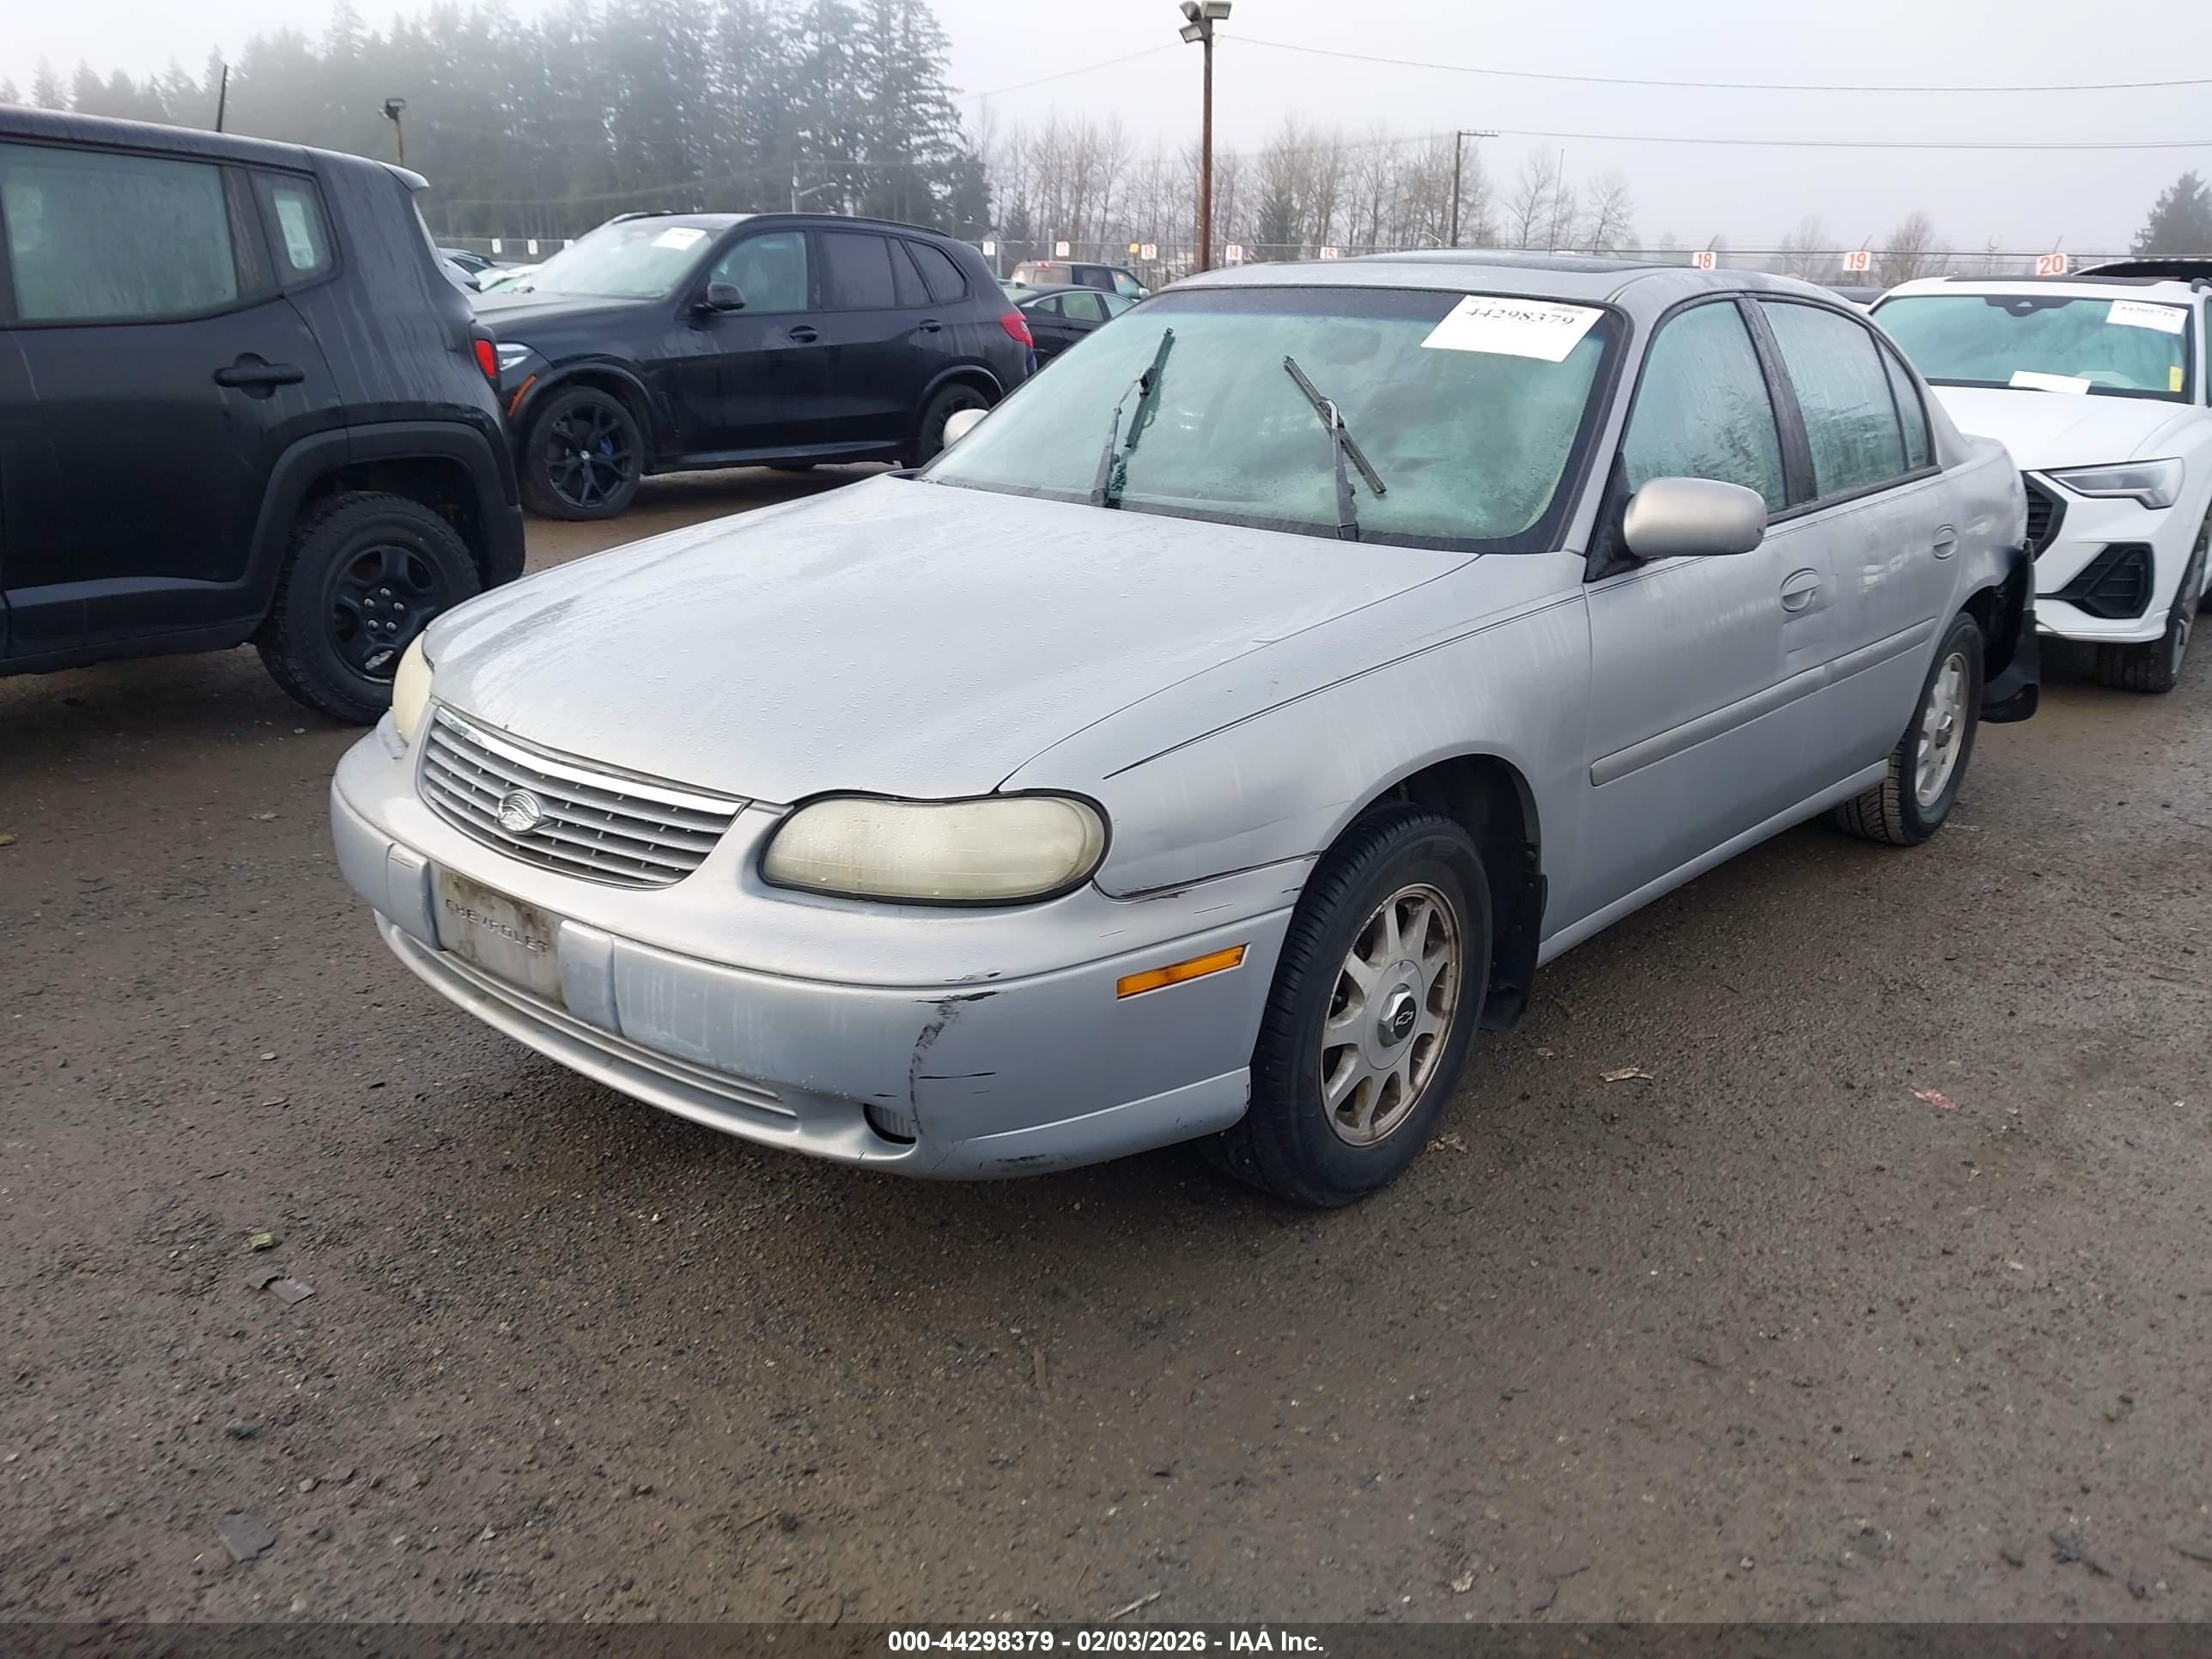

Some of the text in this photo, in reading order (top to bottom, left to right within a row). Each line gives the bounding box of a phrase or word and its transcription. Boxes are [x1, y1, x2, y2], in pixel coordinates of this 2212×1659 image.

[1698, 252, 1712, 269] 18
[1850, 253, 1866, 269] 19
[2039, 255, 2064, 274] 20
[1465, 307, 1576, 325] 44298379
